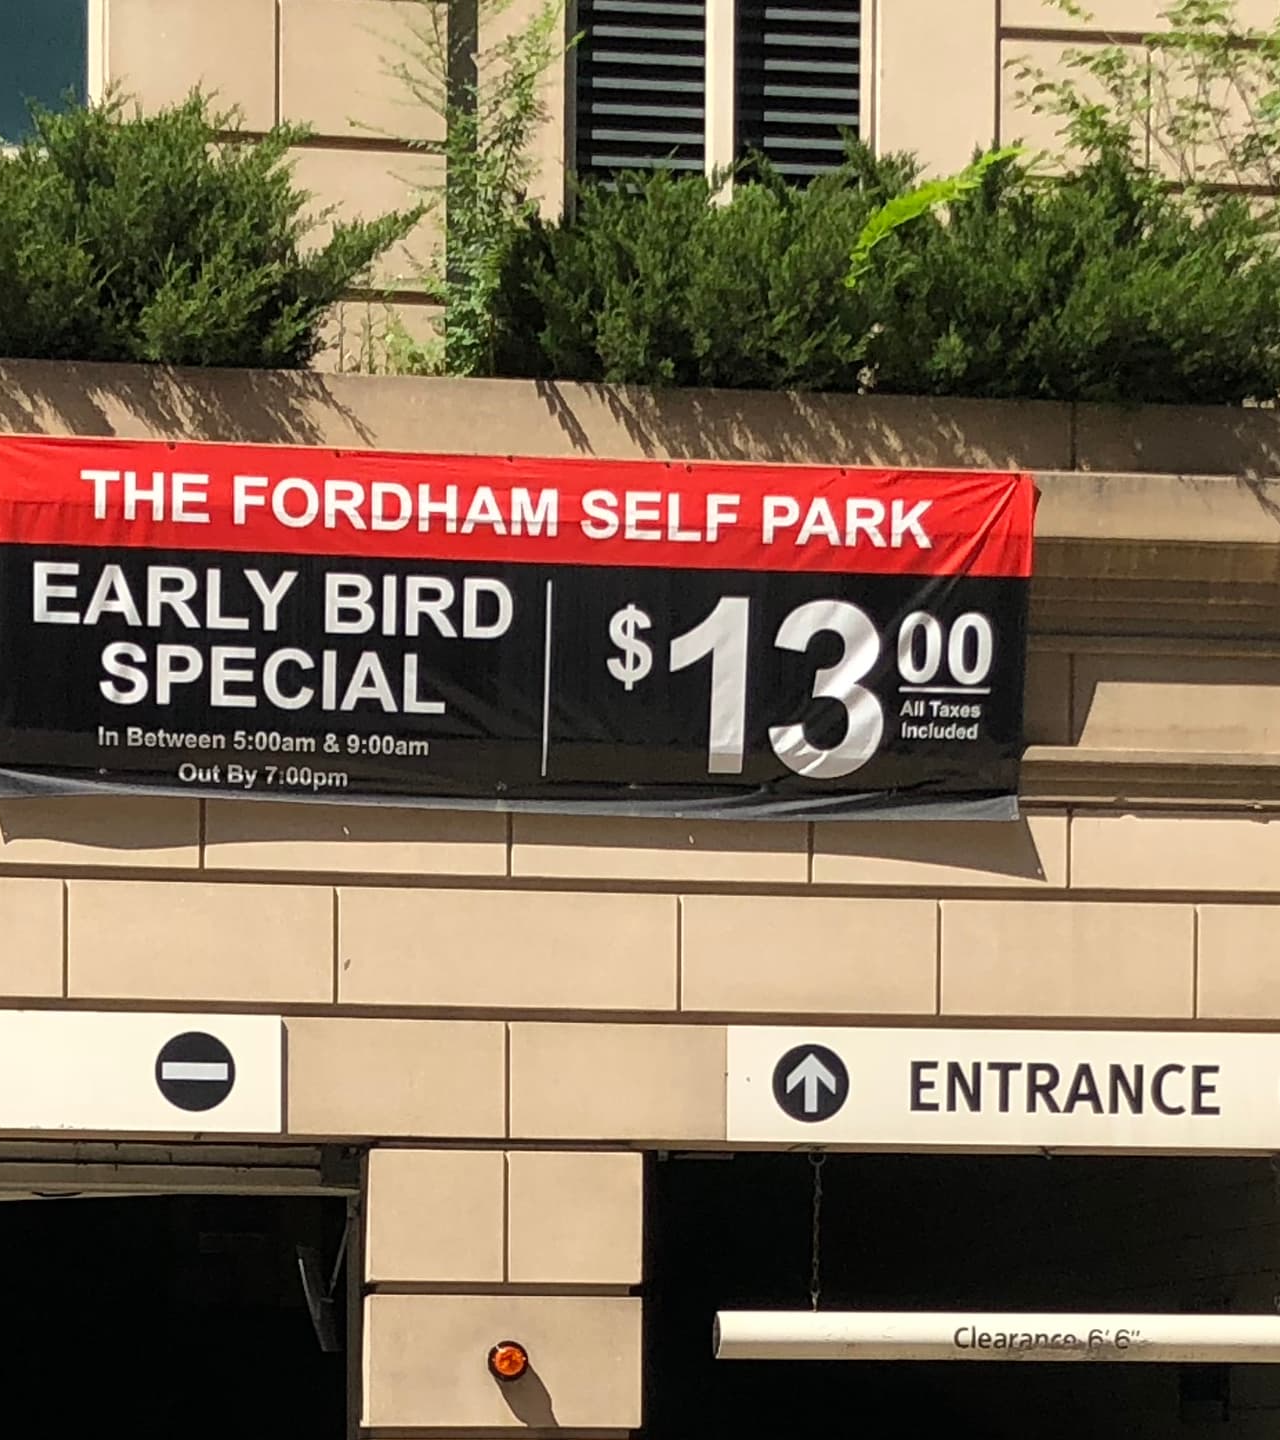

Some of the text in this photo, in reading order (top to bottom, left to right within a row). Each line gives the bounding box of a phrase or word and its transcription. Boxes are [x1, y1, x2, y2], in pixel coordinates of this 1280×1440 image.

[80, 469, 934, 549] THE FORDHAM SELF PARK
[32, 560, 513, 640] EARLY BIRD
[98, 641, 447, 715] SPECIAL
[899, 700, 982, 719] All Taxes
[97, 725, 430, 757] In Between 5:00am & 9:00am
[901, 721, 979, 741] Included
[178, 762, 349, 791] Out By 7:00pm
[908, 1059, 1221, 1117] ENTRANCE
[953, 1325, 1077, 1350] Clearance
